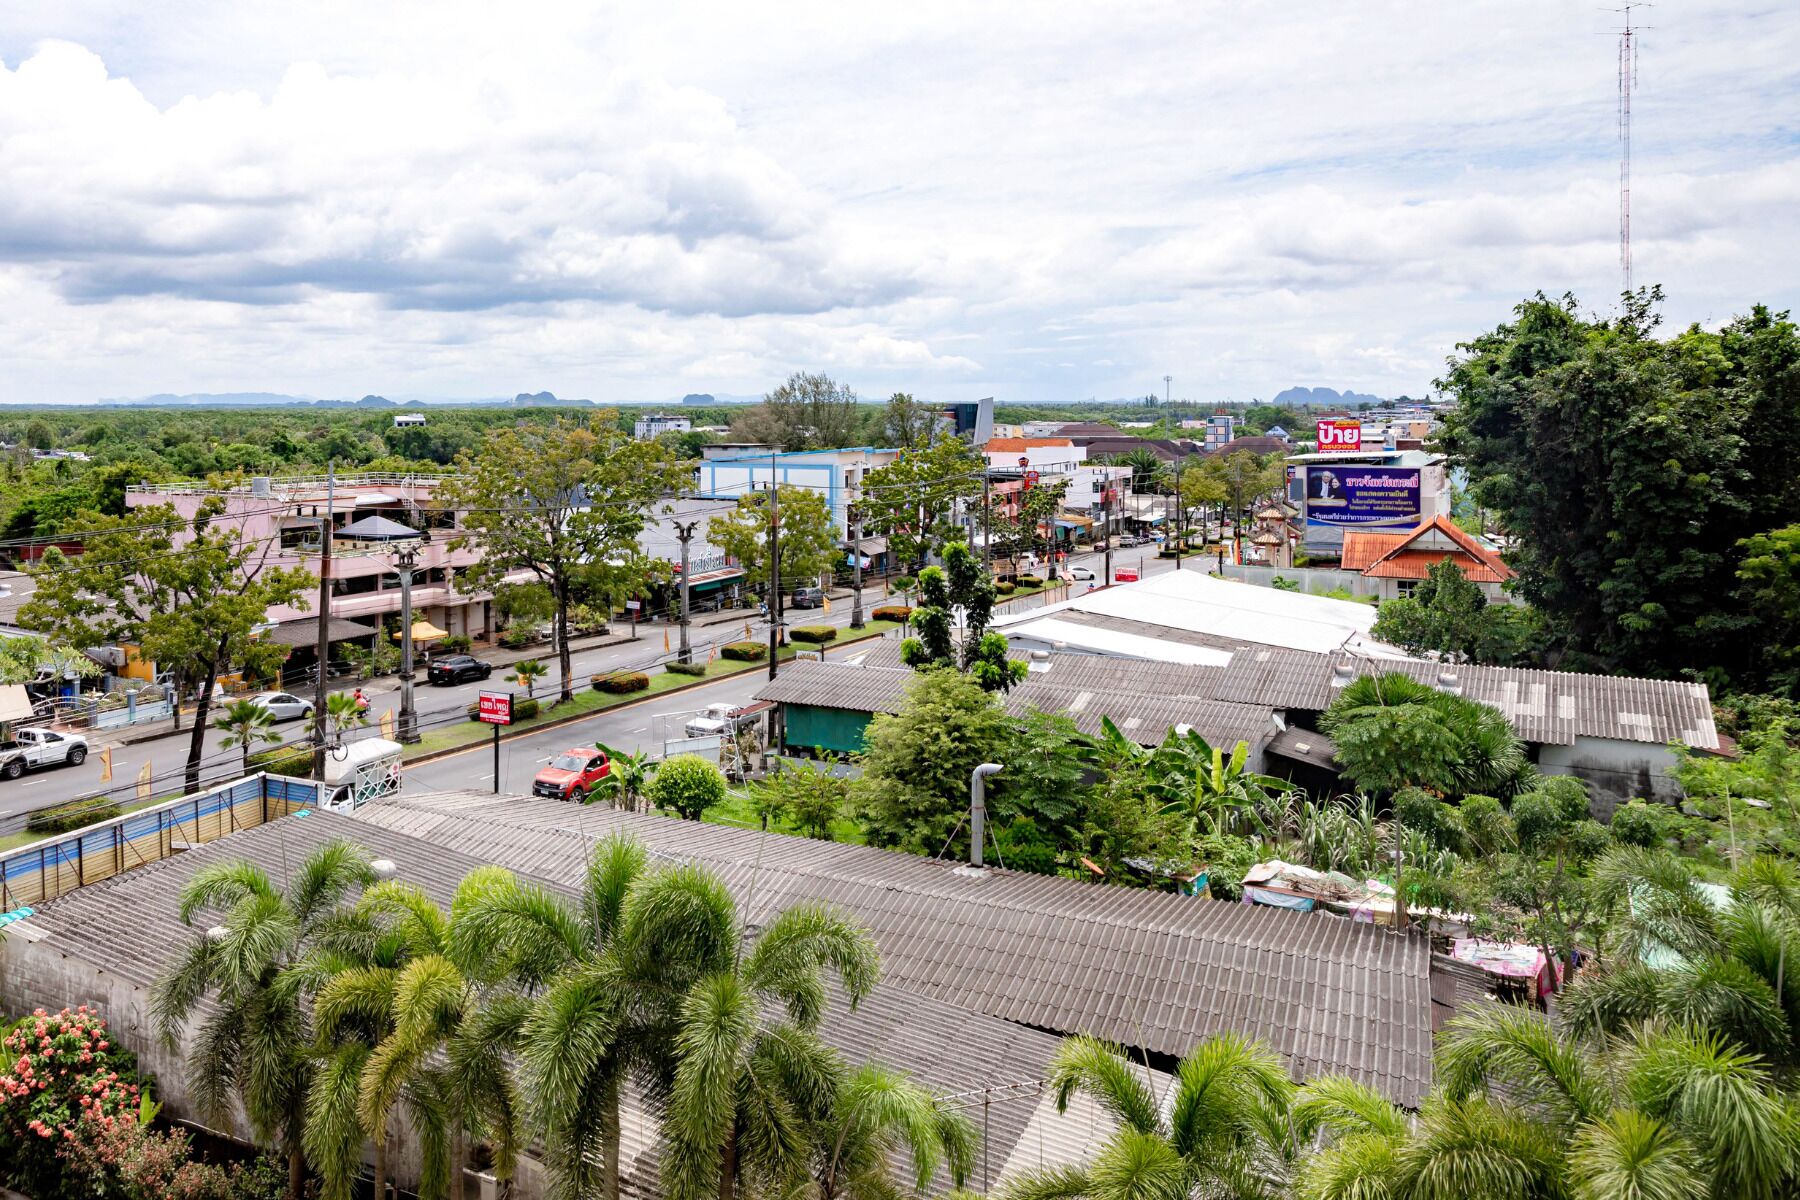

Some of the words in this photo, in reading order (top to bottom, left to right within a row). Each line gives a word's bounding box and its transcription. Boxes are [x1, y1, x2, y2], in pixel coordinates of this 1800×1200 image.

[1319, 423, 1359, 443] ป้าย
[1346, 473, 1418, 487] ชาวจังหวัดกระบี่
